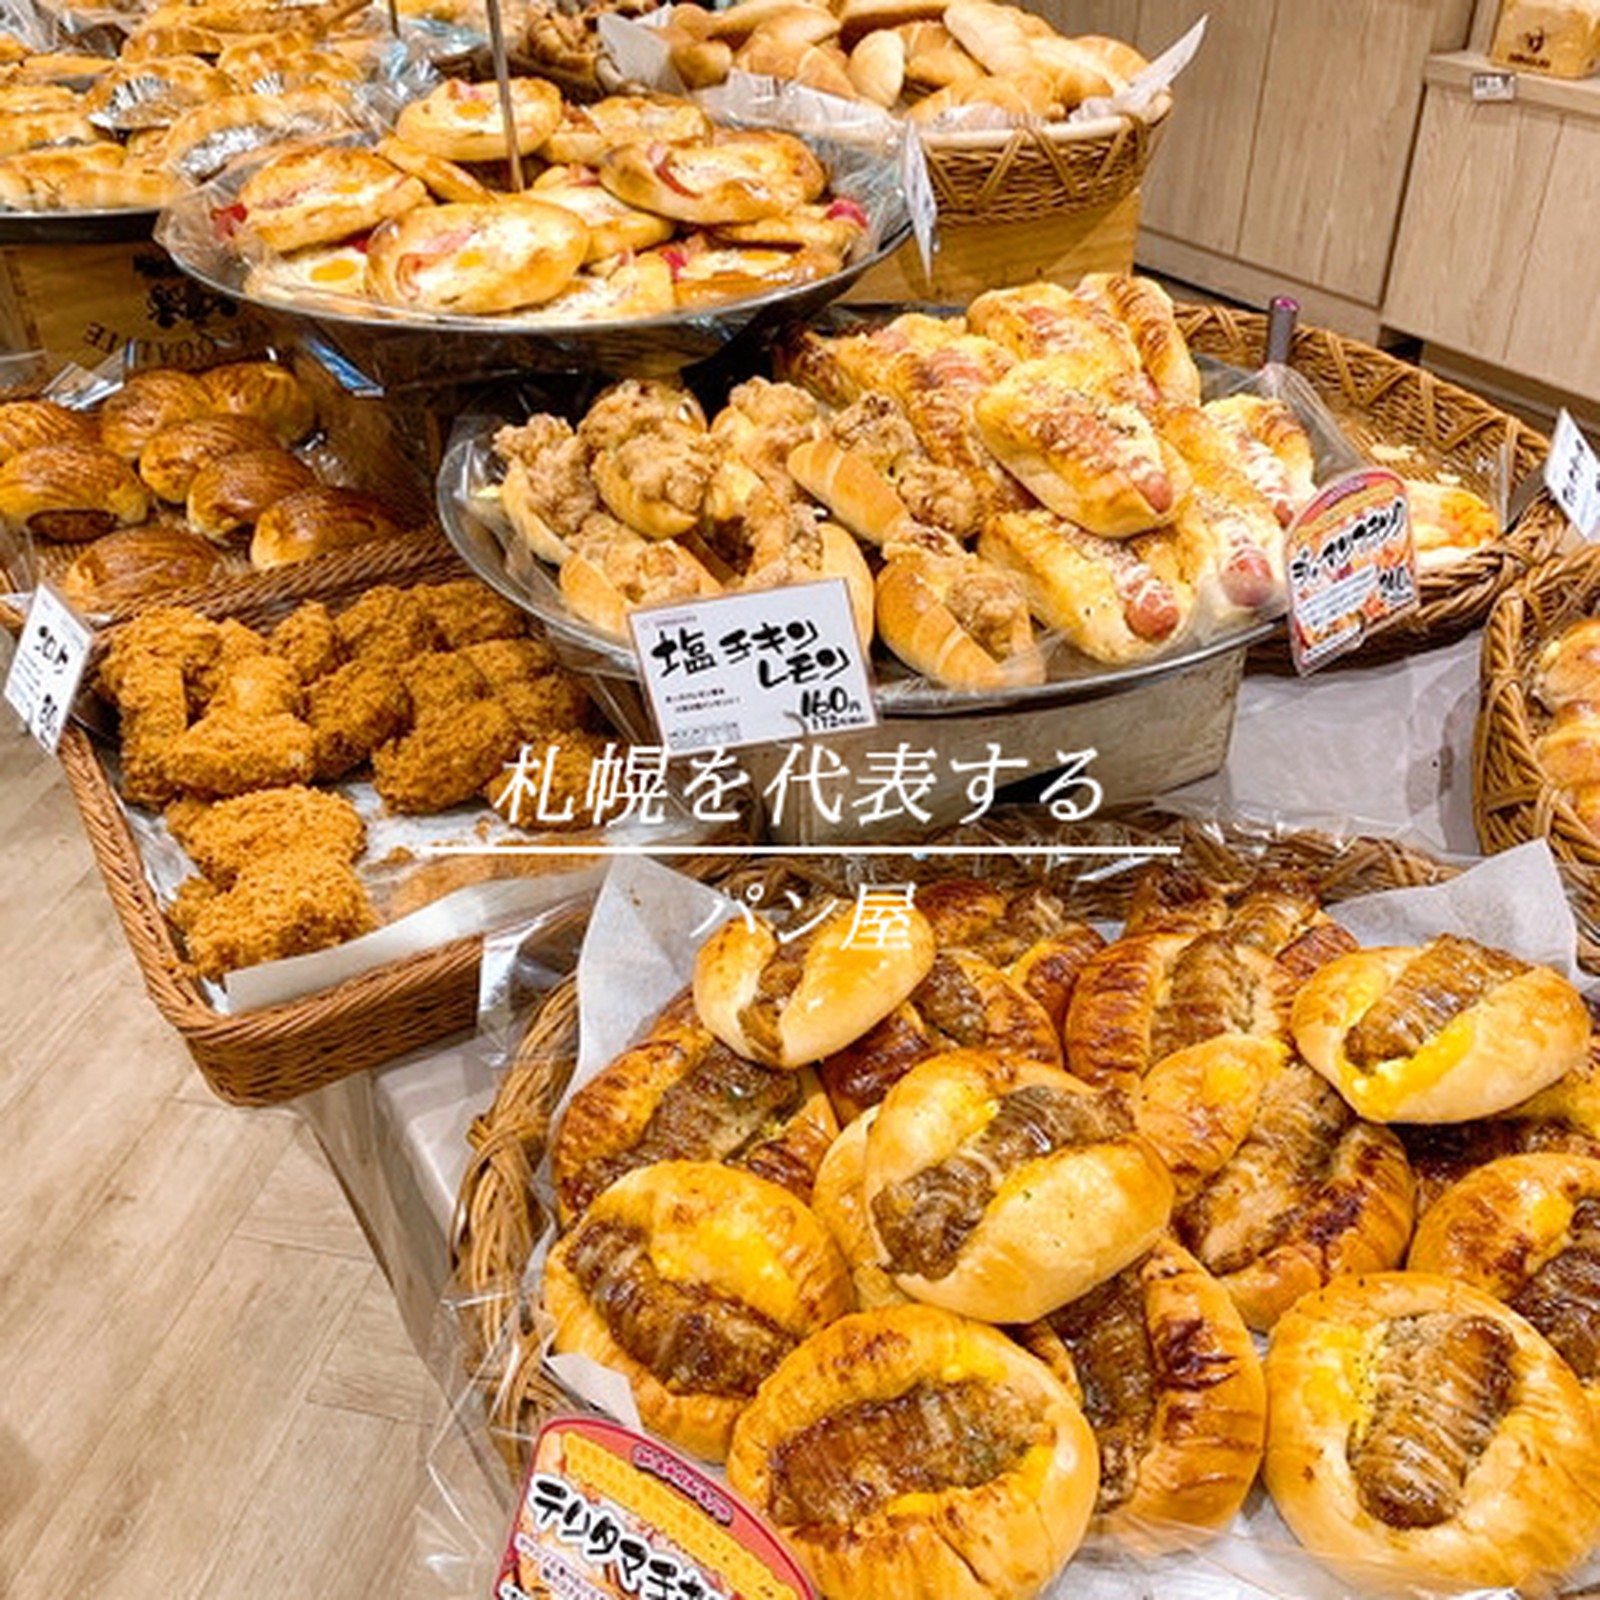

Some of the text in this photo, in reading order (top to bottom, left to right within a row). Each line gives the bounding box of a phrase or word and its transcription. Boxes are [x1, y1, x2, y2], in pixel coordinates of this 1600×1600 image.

[650, 620, 818, 677] 塩チキン
[758, 647, 850, 689] レモン
